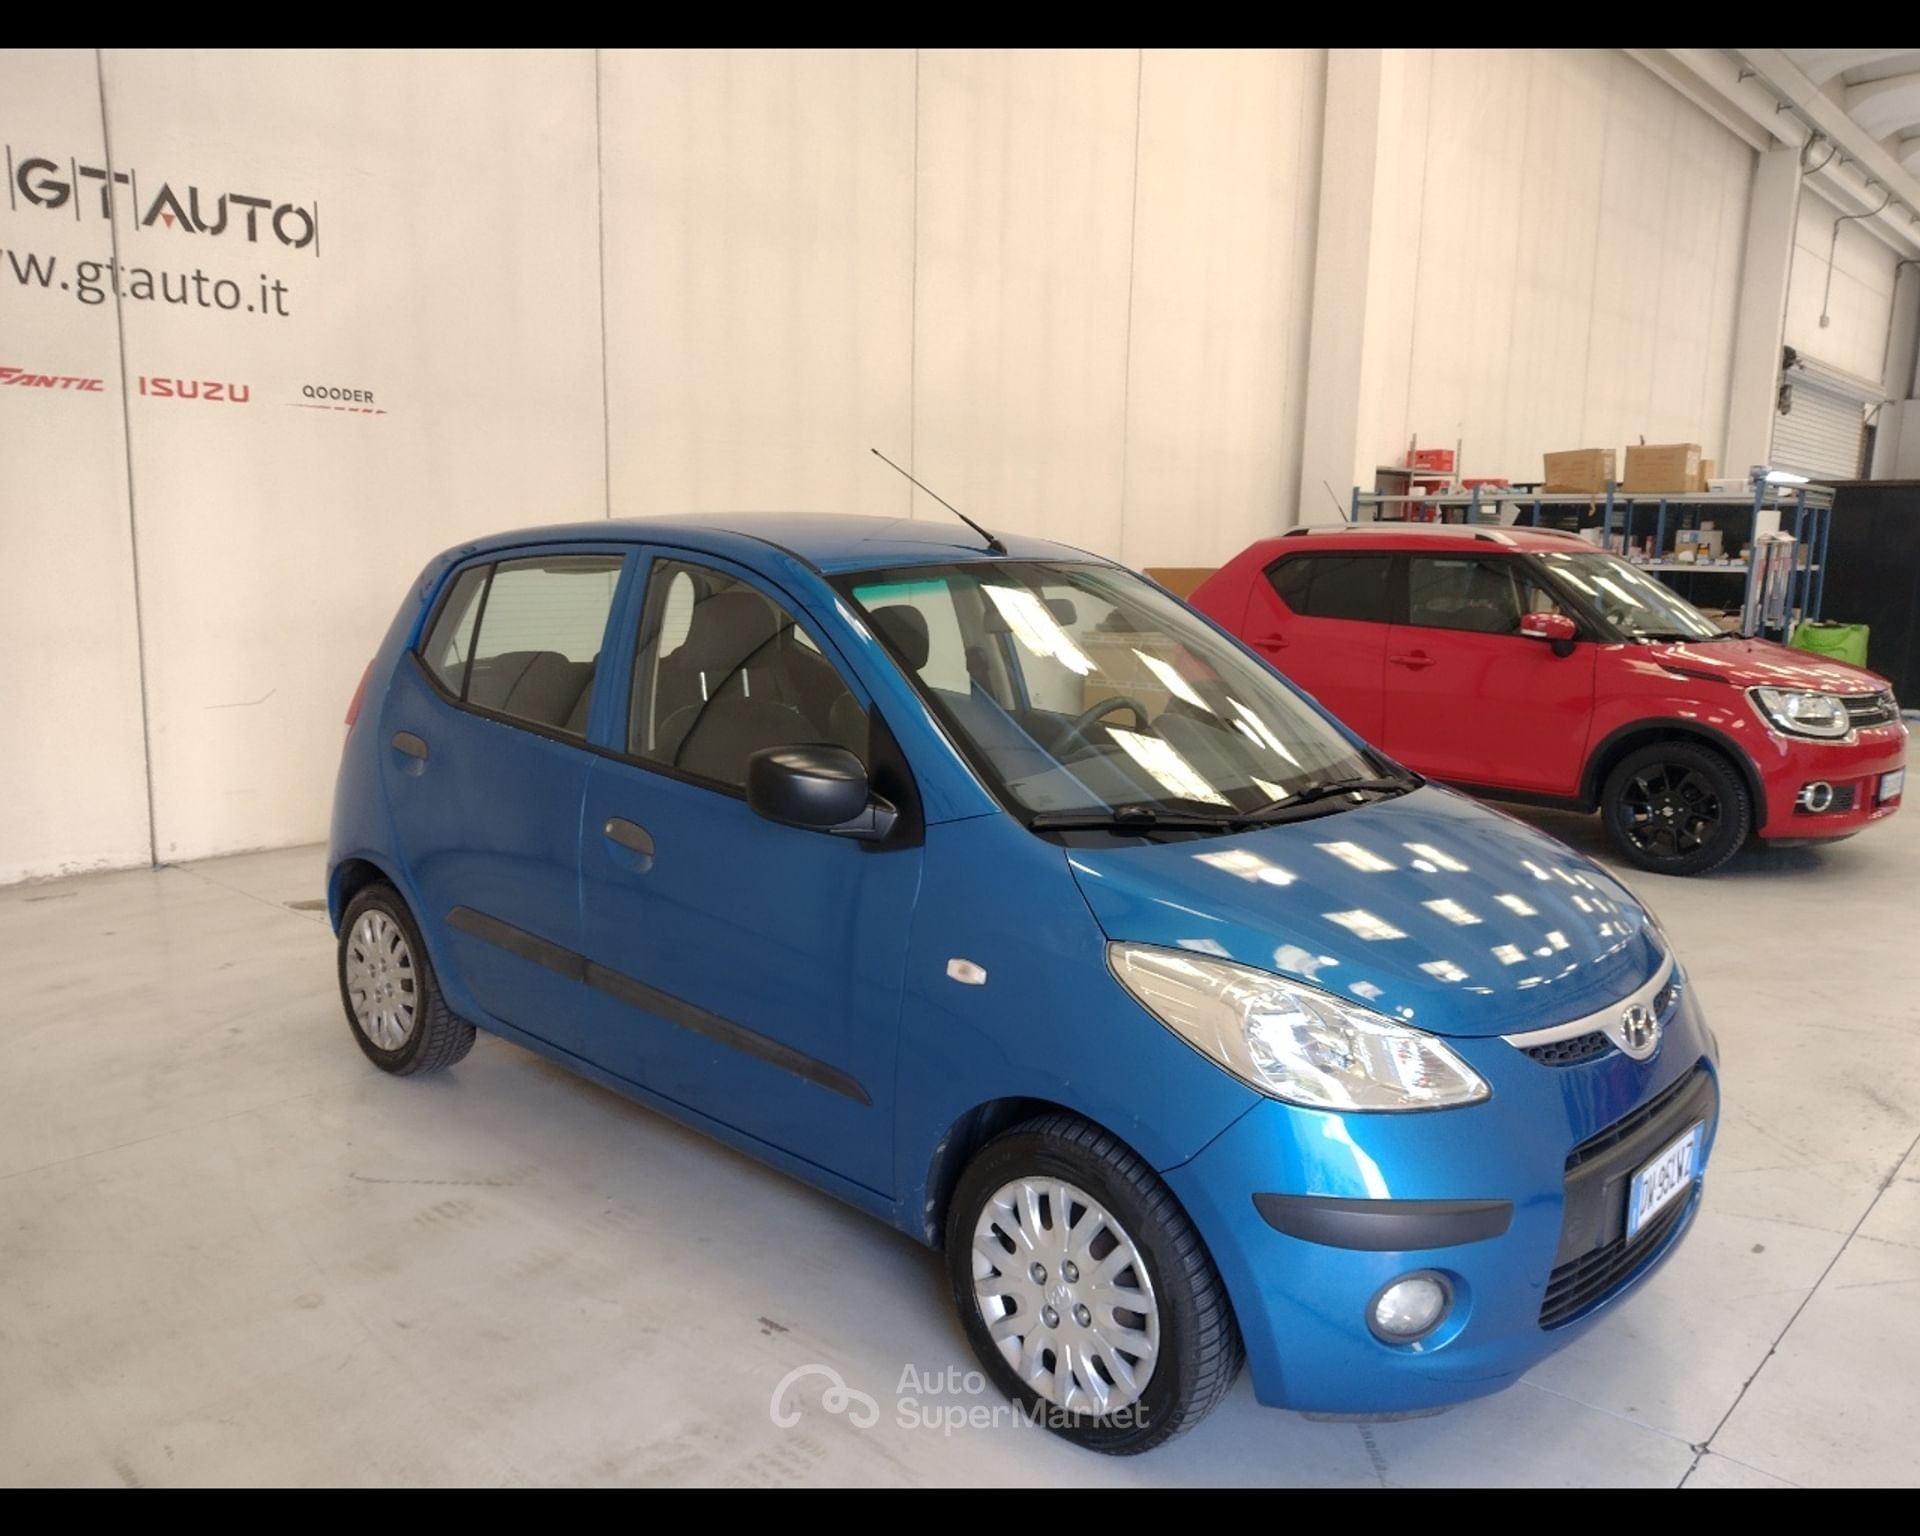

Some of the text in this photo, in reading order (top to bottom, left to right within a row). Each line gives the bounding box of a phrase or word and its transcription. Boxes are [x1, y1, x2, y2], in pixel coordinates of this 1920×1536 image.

[0, 248, 290, 317] w.gtauto.it
[138, 376, 250, 402] ISUZU
[302, 384, 375, 404] QOODER
